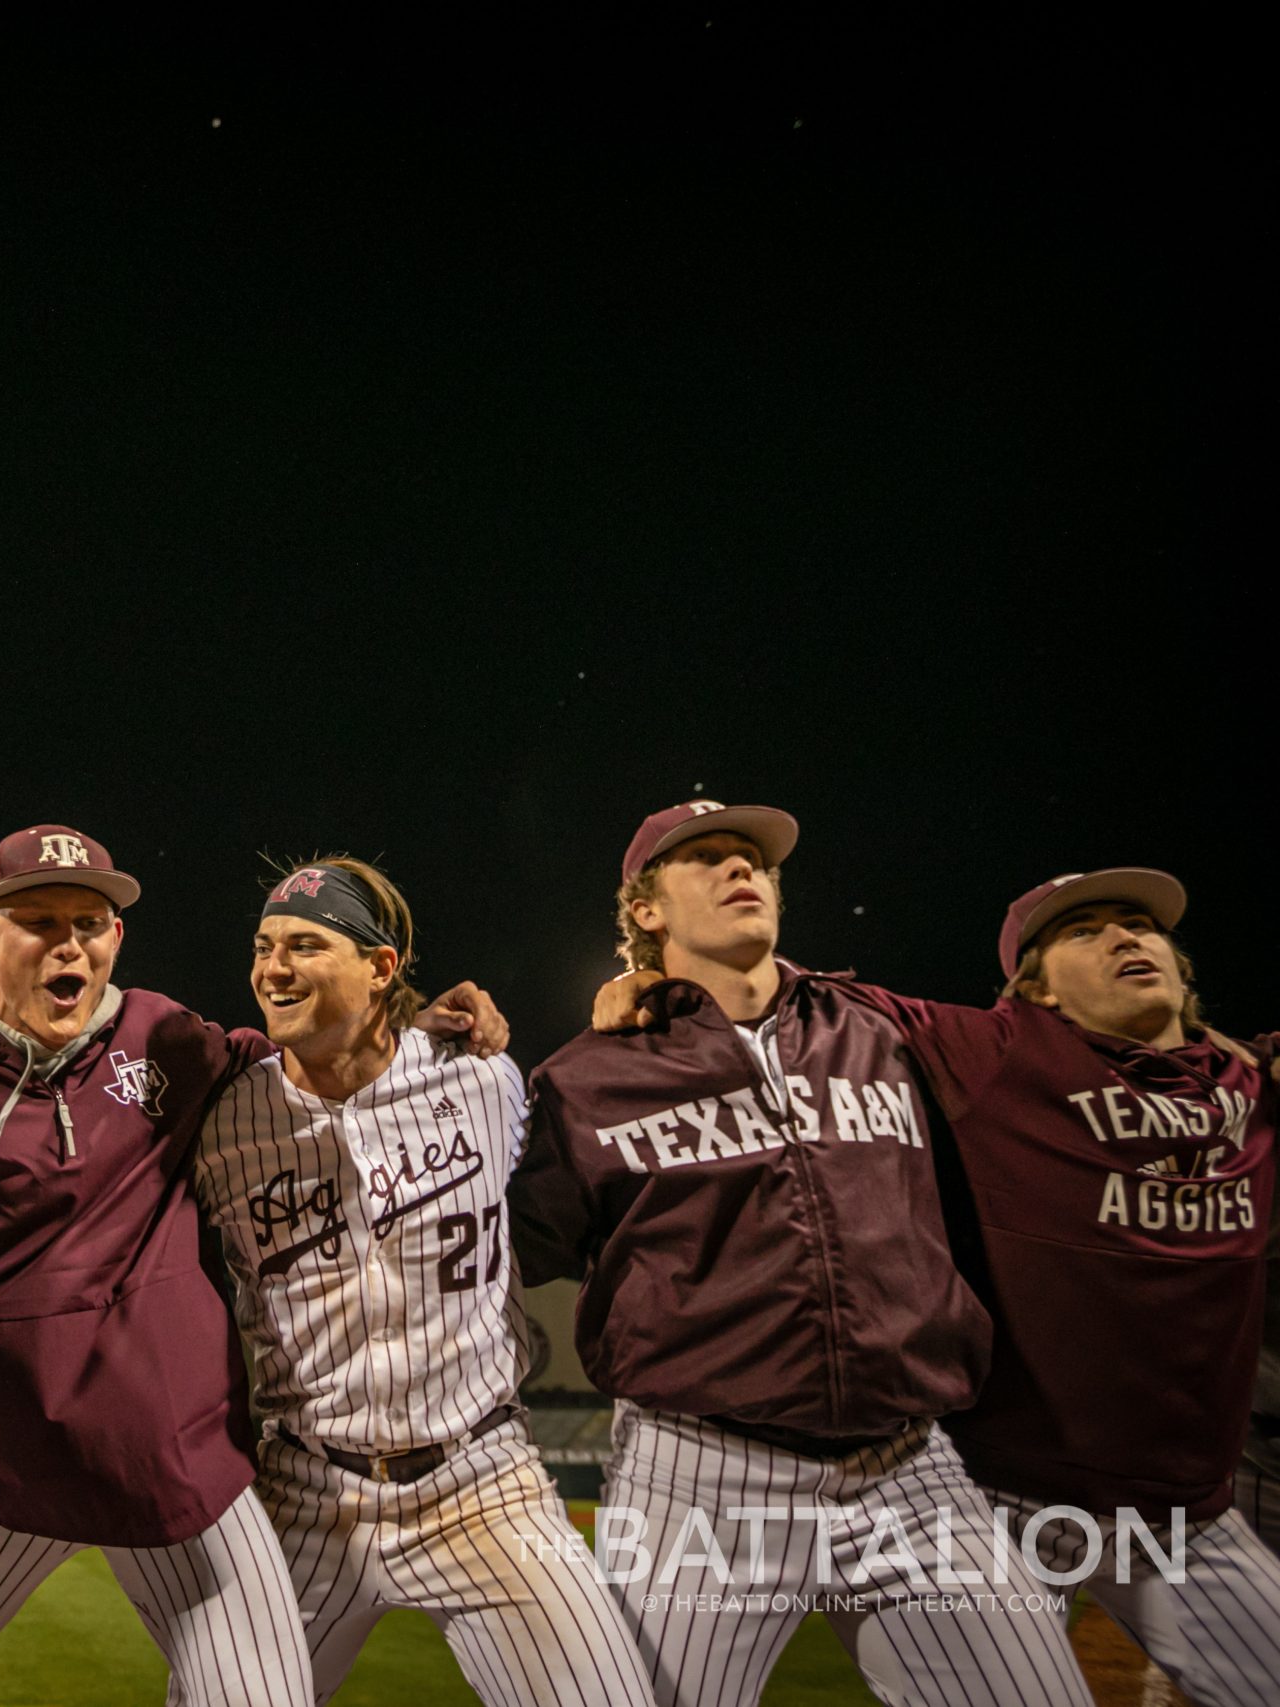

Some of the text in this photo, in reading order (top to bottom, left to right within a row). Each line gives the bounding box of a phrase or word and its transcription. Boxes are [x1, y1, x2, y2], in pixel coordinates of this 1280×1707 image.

[596, 1075, 924, 1174] TEXAS A&M
[1067, 1085, 1210, 1142] TEXAS
[249, 1130, 483, 1260] Aggies
[1098, 1172, 1256, 1233] AGGIES
[437, 1201, 501, 1295] 27
